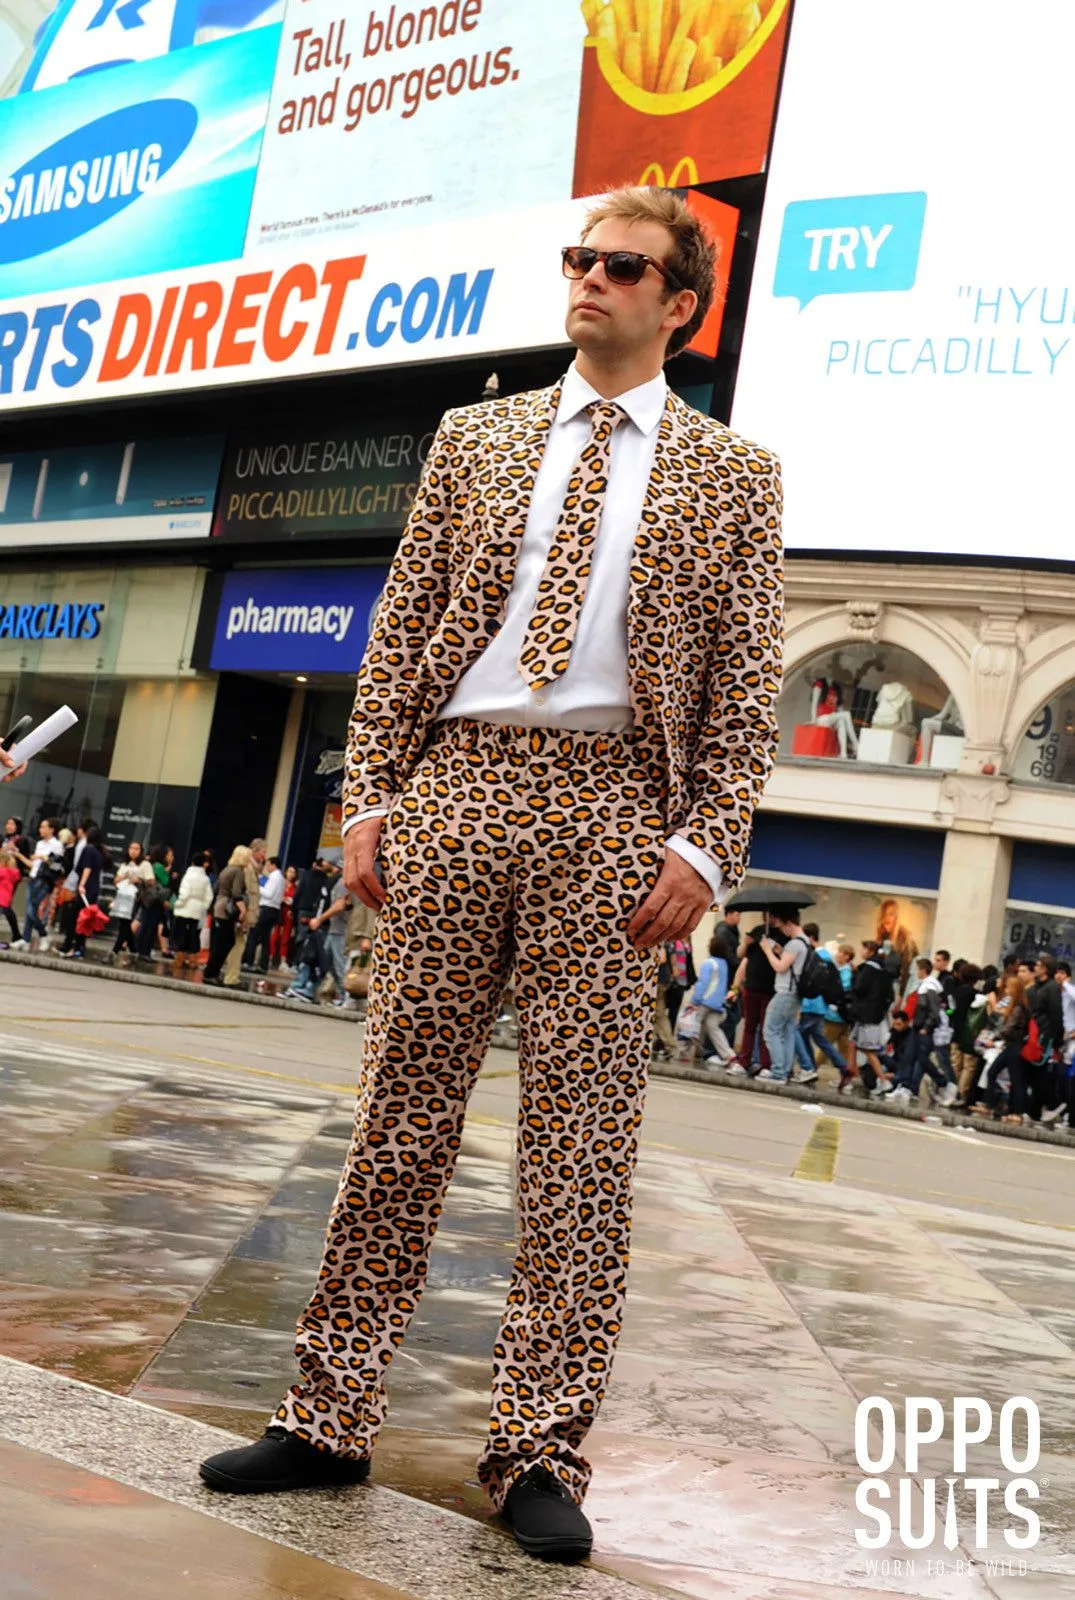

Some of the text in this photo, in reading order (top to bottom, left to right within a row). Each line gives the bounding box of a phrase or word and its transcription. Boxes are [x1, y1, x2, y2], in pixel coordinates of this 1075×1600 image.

[292, 0, 482, 76] Tall, blonde
[278, 47, 520, 134] and gorgeous.
[0, 143, 162, 224] SAMSUNG
[803, 224, 894, 272] TRY
[957, 285, 1075, 325] "HYU
[826, 337, 1071, 377] PICCADILLY
[235, 441, 320, 479] UNIQUE
[320, 433, 414, 473] BANNER
[226, 597, 354, 642] pharmacy
